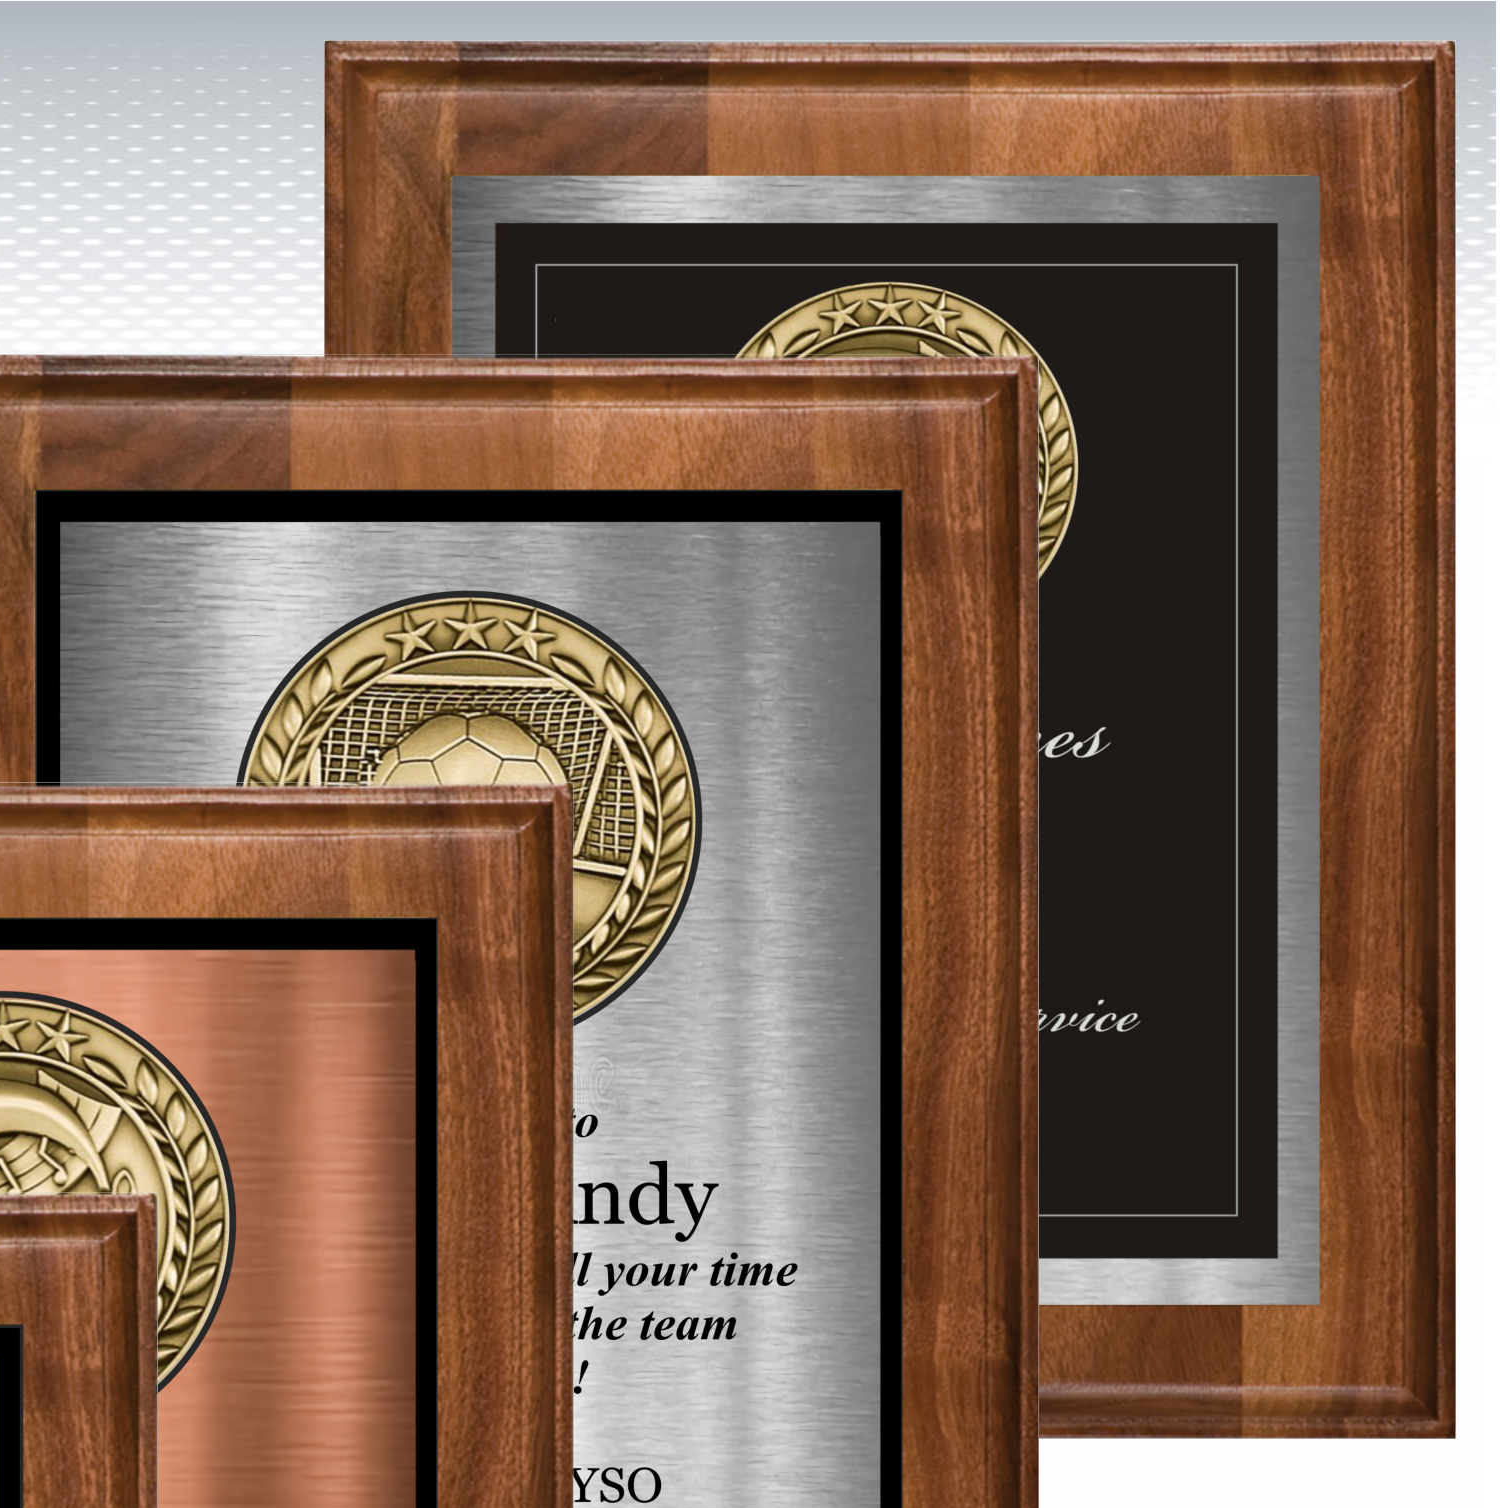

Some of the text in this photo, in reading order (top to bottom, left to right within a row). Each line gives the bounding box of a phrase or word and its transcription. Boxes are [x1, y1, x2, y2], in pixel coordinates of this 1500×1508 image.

[1041, 726, 1111, 759] es
[573, 1160, 719, 1243] ndy
[598, 1263, 698, 1297] your
[710, 1252, 798, 1287] time
[640, 1311, 737, 1341] team
